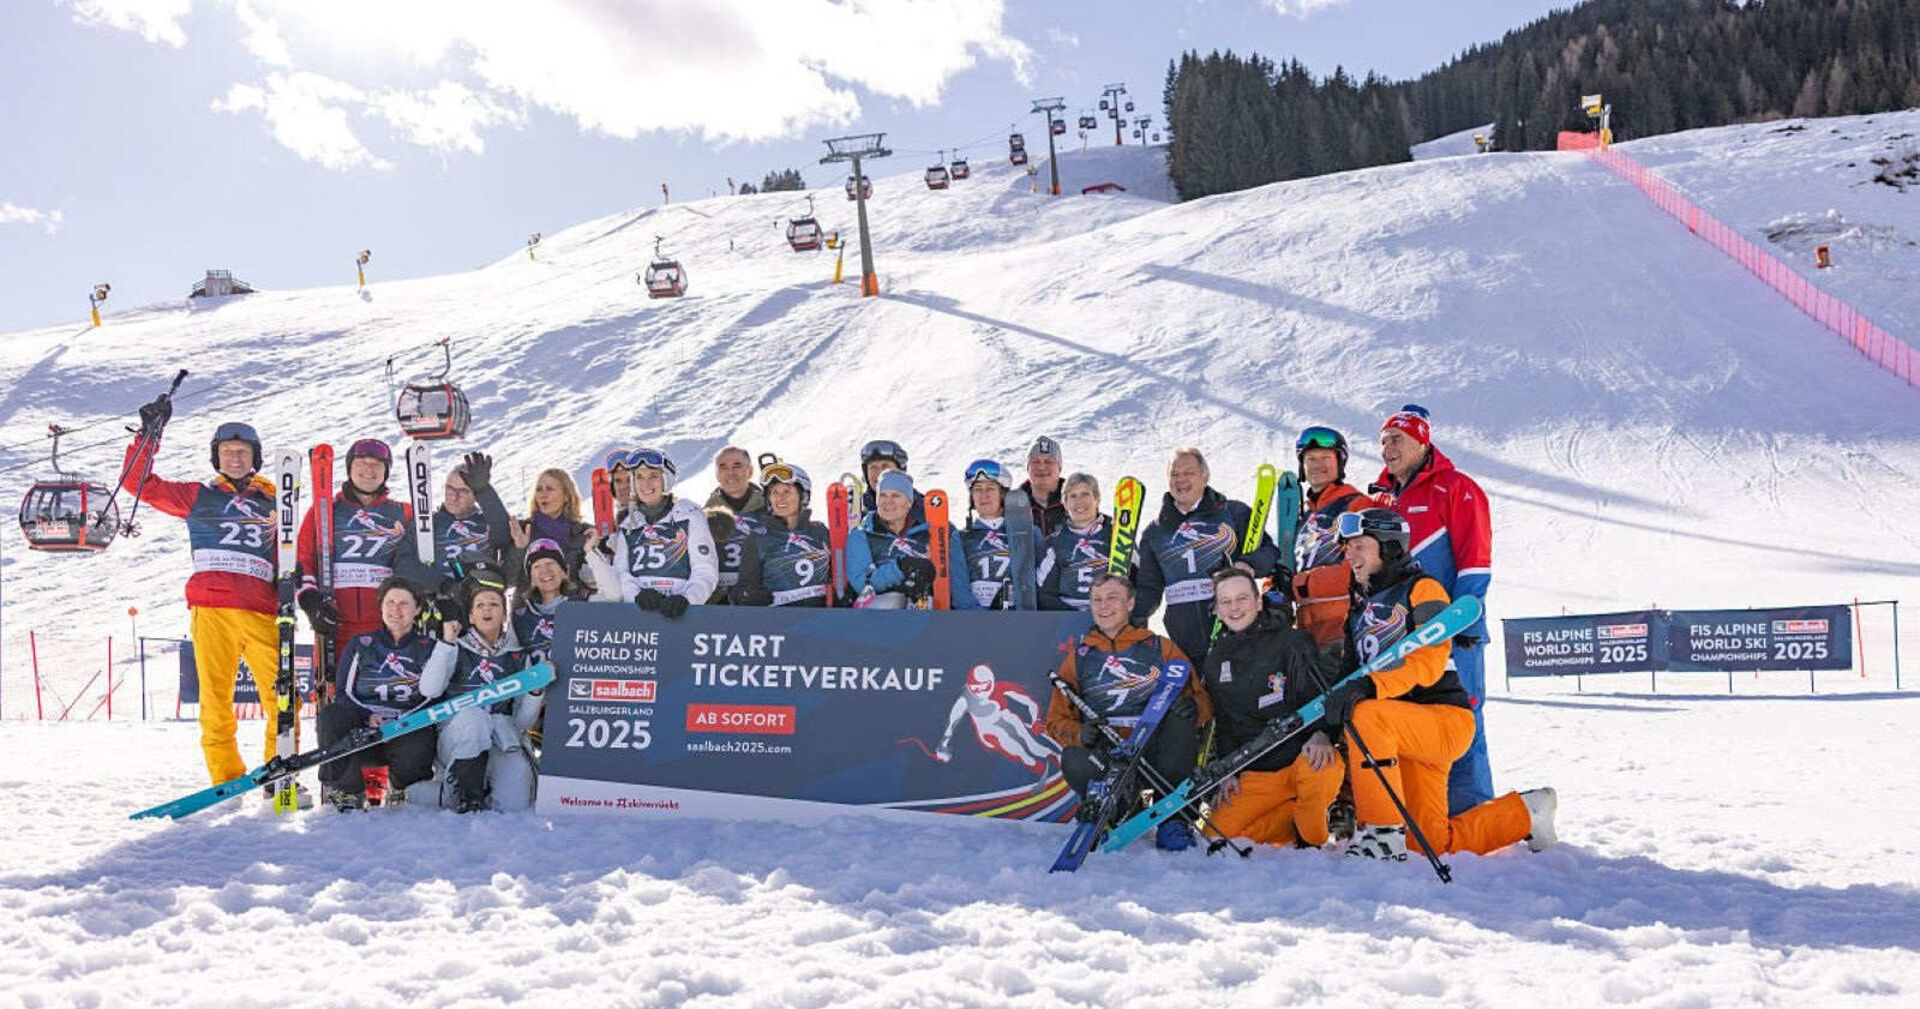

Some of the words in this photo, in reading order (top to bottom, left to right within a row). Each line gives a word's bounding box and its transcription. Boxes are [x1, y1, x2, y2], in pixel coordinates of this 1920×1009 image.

[416, 462, 431, 533] HEAD
[282, 473, 293, 545] HEAD
[219, 522, 263, 547] 23
[341, 535, 388, 559] 27
[632, 545, 667, 572] 25
[1182, 549, 1197, 573] 1
[794, 558, 815, 586] 9
[978, 556, 1011, 580] 17
[1077, 567, 1094, 592] 5
[576, 630, 599, 643] FIS
[601, 631, 660, 645] ALPINE
[1523, 632, 1543, 643] FIS
[1546, 629, 1593, 642] ALPINE
[1690, 624, 1711, 636] FIS
[1714, 623, 1767, 635] ALPINE
[693, 633, 786, 658] START
[1524, 645, 1571, 657] WORLD
[1573, 643, 1593, 654] SKI
[1690, 639, 1742, 650] WORLD
[1745, 638, 1767, 649] SKI
[1774, 642, 1828, 660] 2025
[574, 647, 630, 660] WORLD
[634, 648, 658, 661] SKI
[1600, 645, 1648, 663] 2025
[1690, 652, 1767, 662] CHAMPIONSHIPS
[573, 663, 657, 674] CHAMPIONSHIPS
[691, 663, 944, 691] TICKETVERKAUF
[374, 684, 413, 702] 13
[595, 680, 652, 697] saalbach
[427, 679, 522, 721] HEAD
[1106, 688, 1130, 711] 7
[568, 705, 654, 716] SALZBURGERLAND
[696, 712, 718, 725] AB
[722, 713, 787, 727] SOFORT
[565, 718, 652, 749] 2025
[687, 740, 792, 754] saalbach2025.com
